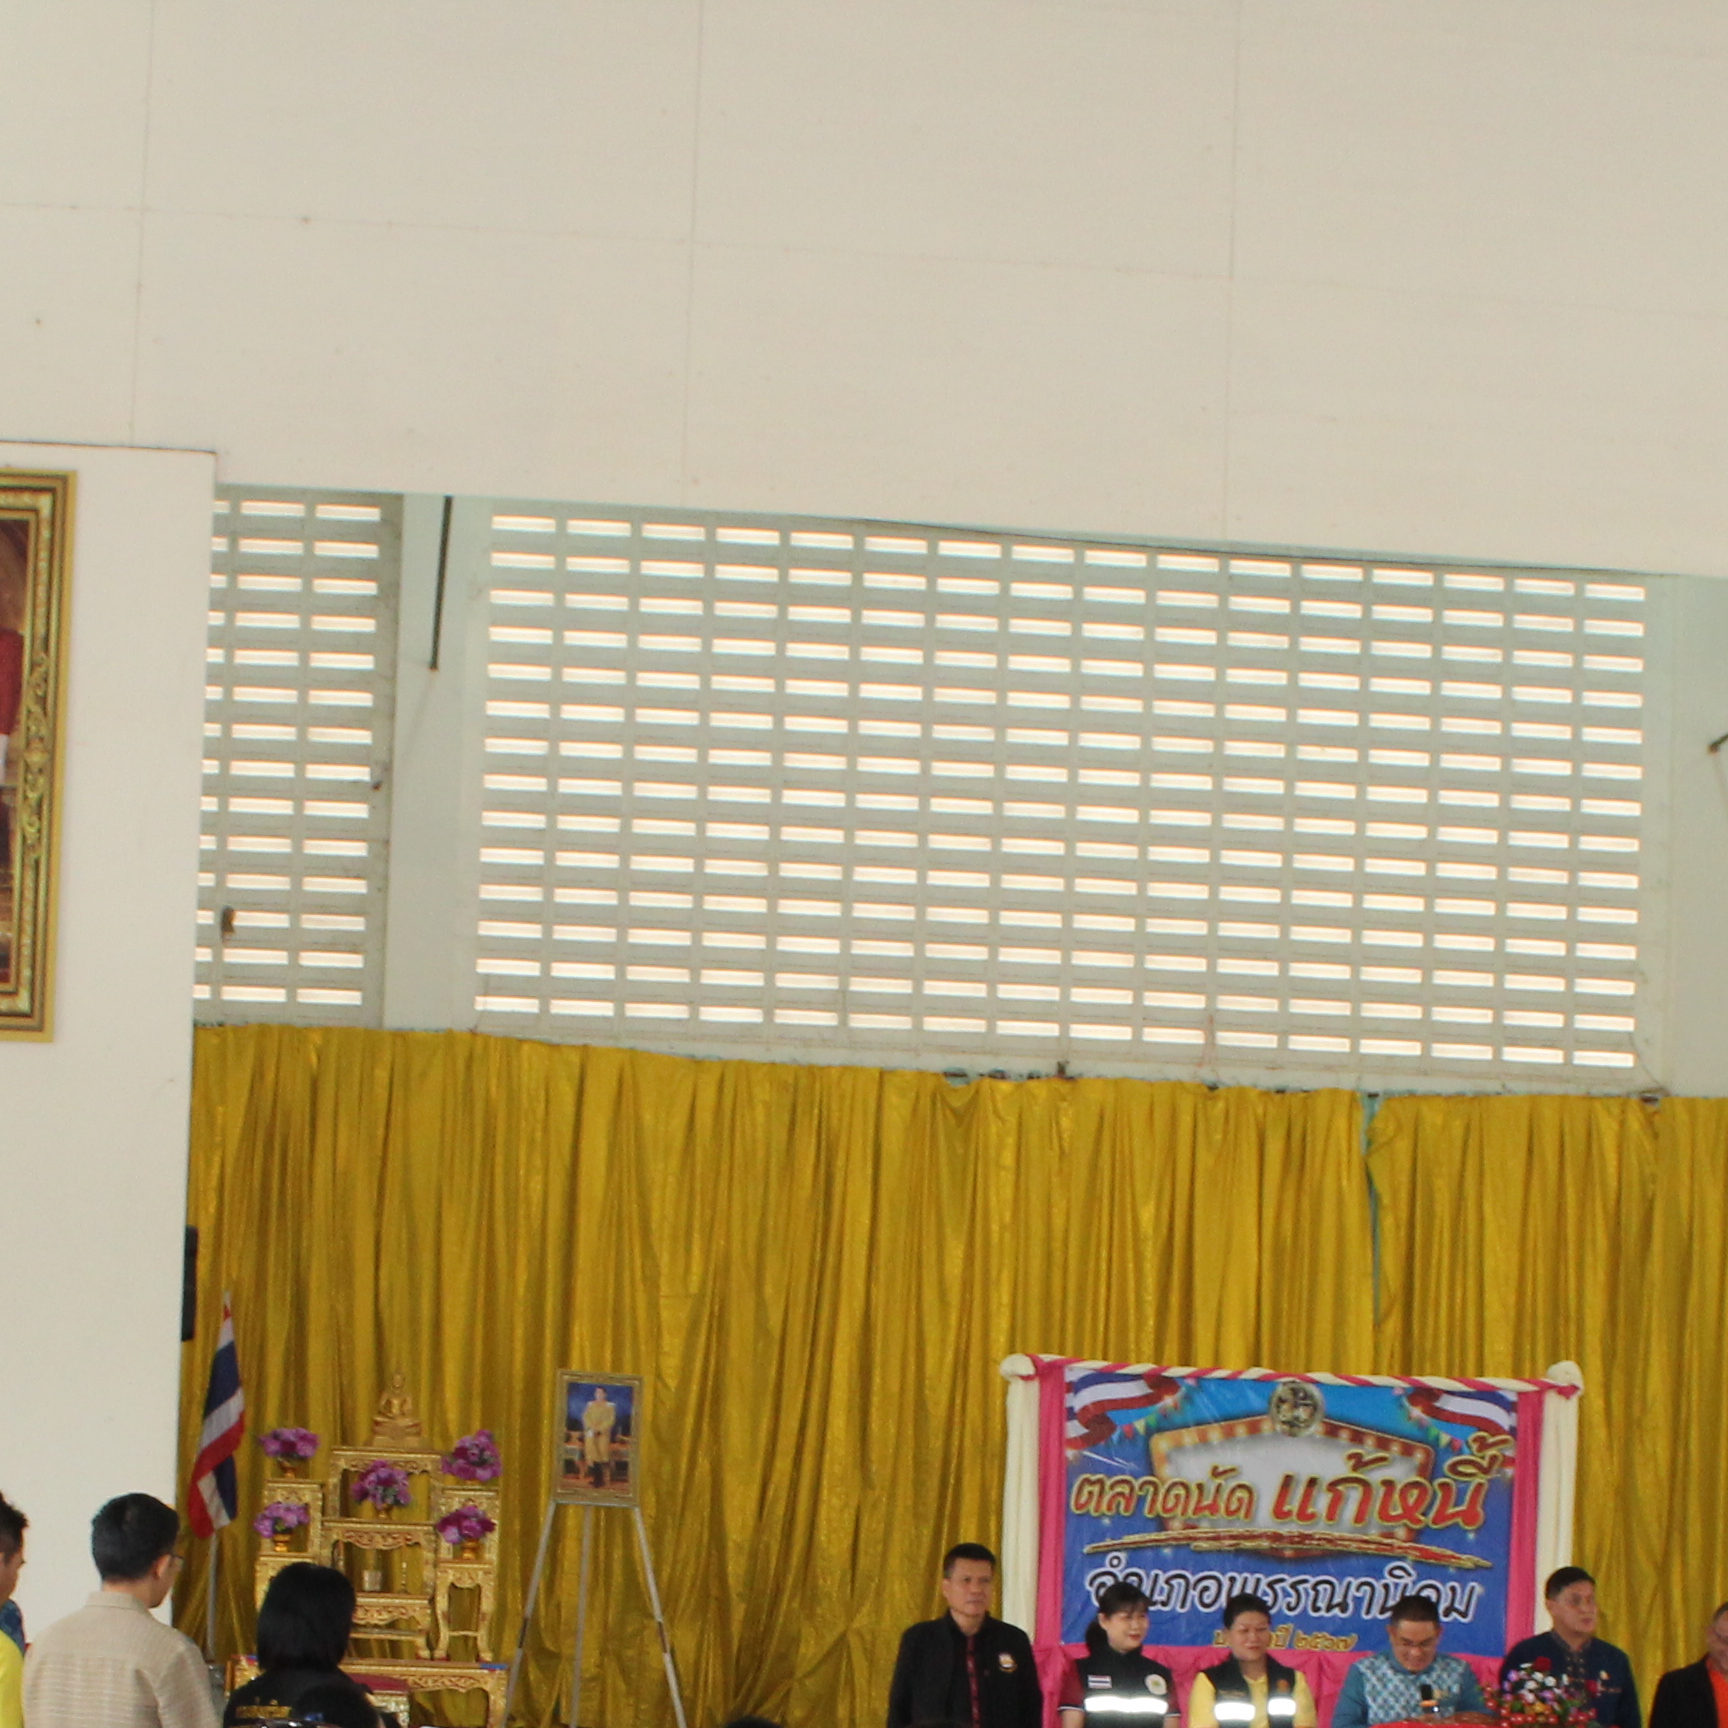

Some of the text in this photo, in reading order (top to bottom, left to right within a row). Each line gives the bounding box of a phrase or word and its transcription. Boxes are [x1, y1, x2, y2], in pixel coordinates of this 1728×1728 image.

[1072, 1432, 1514, 1529] ตลาดนัด แก้หนี้
